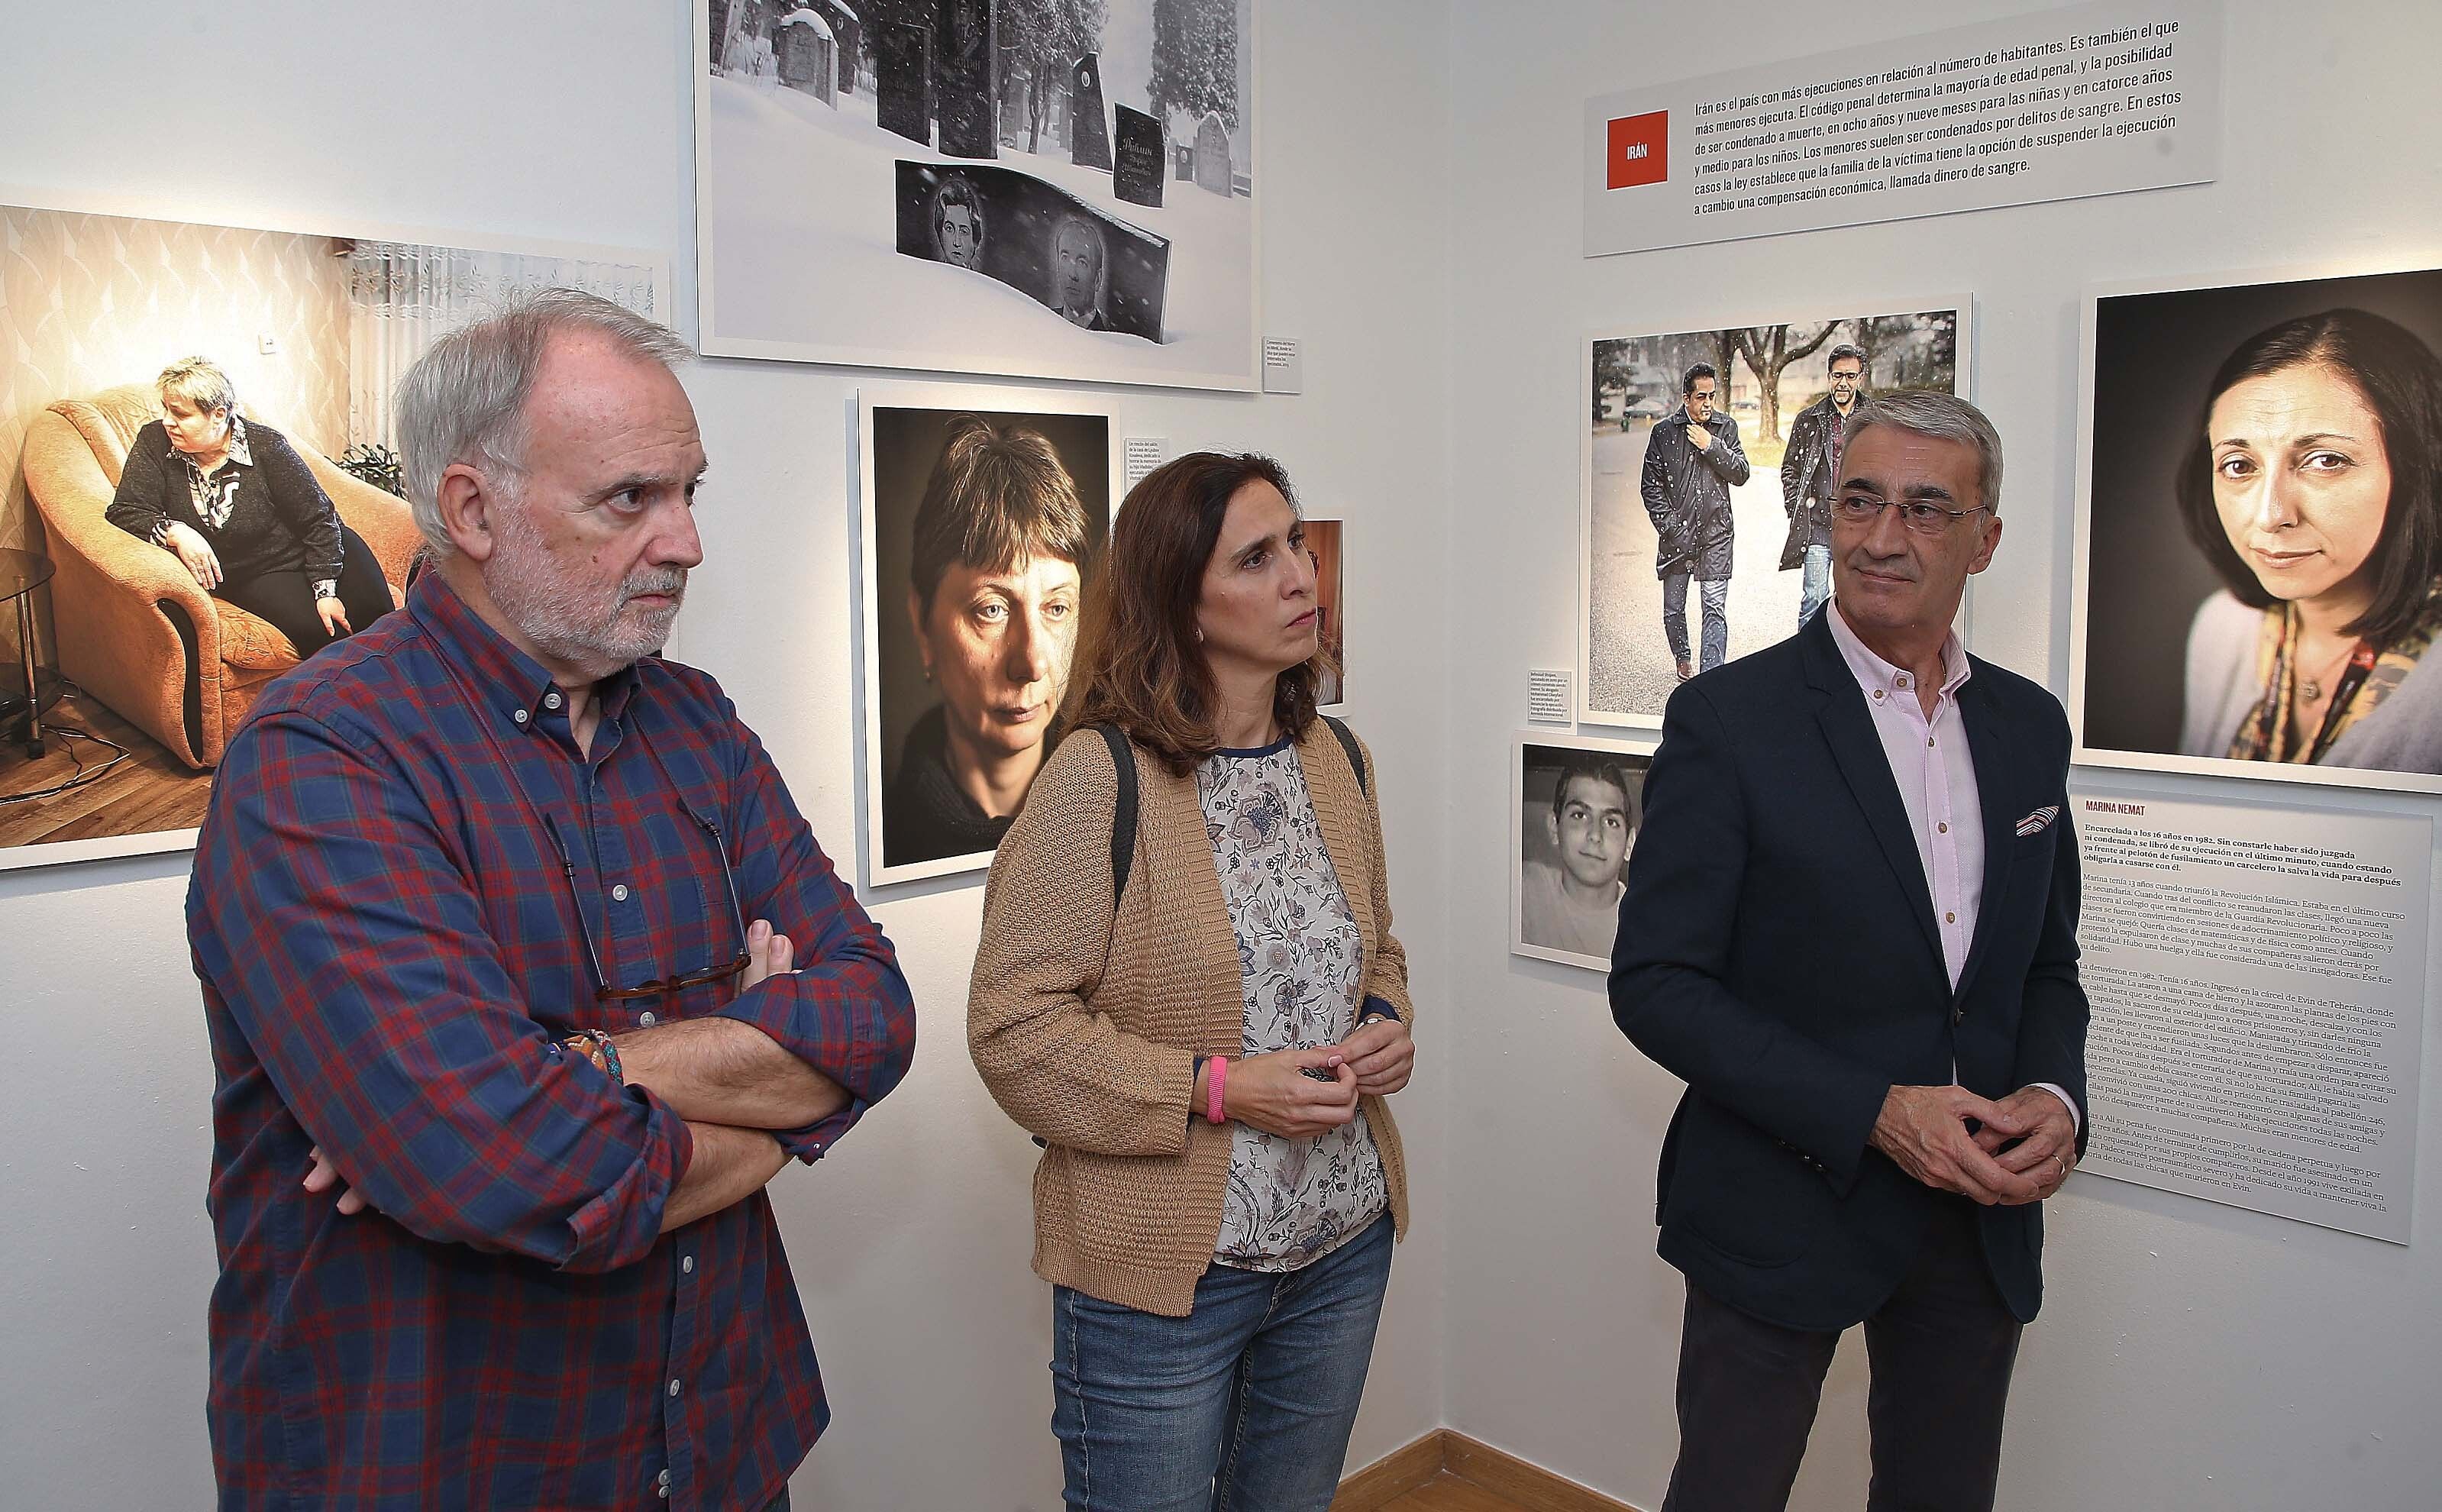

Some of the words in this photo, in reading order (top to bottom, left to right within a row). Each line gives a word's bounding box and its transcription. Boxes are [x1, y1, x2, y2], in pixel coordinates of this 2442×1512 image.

[1695, 102, 1713, 115] Irán
[1716, 102, 1726, 111] es
[1729, 96, 1736, 109] el
[1739, 93, 1759, 111] país
[1762, 92, 1778, 104] con
[1781, 86, 1801, 100] más
[1804, 77, 1862, 99] ejecuciones
[1865, 75, 1878, 86] en
[1882, 64, 1923, 83] relación
[1927, 60, 1936, 75] al
[1940, 57, 1980, 73] número
[1984, 51, 1997, 65] de
[2001, 42, 2066, 62] habitantes.
[2070, 35, 2084, 50] Es
[2088, 26, 2137, 47] también
[2141, 22, 2151, 37] el
[2155, 21, 2178, 37] que
[1695, 121, 1714, 135] más
[1716, 117, 1756, 132] menores
[1759, 109, 1796, 127] ejecuta.
[1799, 105, 1810, 118] El
[1811, 101, 1845, 116] código
[1846, 92, 1874, 113] penal
[1877, 86, 1930, 105] determina
[1933, 82, 1943, 95] la
[1946, 74, 1989, 94] mayoría
[1993, 71, 2006, 86] de
[2010, 65, 2037, 82] edad
[2041, 59, 2076, 81] penal,
[2080, 60, 2087, 74] y
[2091, 55, 2101, 69] la
[2104, 42, 2172, 70] posibilidad
[1694, 142, 1705, 155] de
[1708, 142, 1723, 153] ser
[1725, 131, 1776, 150] condenado
[1778, 132, 1785, 141] a
[1788, 125, 1824, 141] muerte,
[1827, 124, 1839, 134] en
[1843, 117, 1866, 131] ocho
[1869, 113, 1894, 128] años
[1898, 113, 1904, 126] y
[1907, 108, 1938, 121] nueve
[1941, 102, 1976, 116] meses
[1979, 97, 2004, 113] para
[2008, 92, 2024, 105] las
[2028, 86, 2059, 102] niñas
[2063, 86, 2070, 100] y
[2073, 83, 2087, 95] en
[2092, 76, 2138, 92] catorce
[2142, 68, 2172, 84] años
[1694, 166, 1699, 177] y
[1702, 159, 1729, 174] medio
[1732, 157, 1752, 172] para
[1756, 153, 1769, 166] los
[1772, 149, 1800, 163] niños.
[1804, 146, 1820, 158] Los
[1823, 140, 1866, 156] menores
[1869, 133, 1903, 148] suelen
[1907, 131, 1924, 143] ser
[1927, 119, 1992, 140] condenados
[1996, 117, 2014, 133] por
[2016, 111, 2056, 126] delitos
[2060, 105, 2074, 120] de
[2078, 102, 2122, 117] sangre.
[2127, 95, 2142, 110] En
[2146, 92, 2181, 107] estos
[1626, 141, 1648, 160] IRÁN
[1694, 183, 1720, 195] casos
[1723, 178, 1731, 190] la
[1734, 176, 1747, 190] ley
[1749, 170, 1797, 186] establece
[1798, 169, 1816, 182] que
[1819, 164, 1827, 177] la
[1830, 159, 1864, 175] familia
[1867, 157, 1881, 170] de
[1882, 155, 1891, 168] la
[1894, 150, 1932, 166] víctima
[1936, 147, 1962, 160] tiene
[1966, 143, 1975, 156] la
[1978, 137, 2015, 157] opción
[2019, 134, 2033, 148] de
[2037, 125, 2098, 147] suspender
[2101, 123, 2112, 137] la
[2116, 114, 2175, 137] ejecución
[1694, 205, 1699, 215] a
[1702, 198, 1734, 213] cambio
[1737, 198, 1755, 208] una
[1757, 185, 1826, 206] compensación
[1827, 179, 1886, 196] económica,
[1890, 171, 1930, 188] llamada
[1933, 169, 1968, 182] dinero
[1971, 163, 1984, 177] de
[1988, 160, 2030, 175] sangre.
[2085, 800, 2117, 813] MARINA
[2118, 803, 2146, 816] NEMAT
[2083, 853, 2117, 864] obligarla
[2083, 843, 2092, 851] ya
[2094, 844, 2117, 853] frente
[2127, 849, 2157, 858] pelotón
[2170, 852, 2222, 865] fusilamiento
[2236, 862, 2276, 871] carcelero
[2277, 864, 2285, 873] la
[2287, 867, 2310, 875] salva
[2321, 870, 2340, 879] vida
[2363, 874, 2401, 886] después
[2085, 824, 2131, 835] Encarcelada
[2139, 829, 2151, 837] los
[2232, 838, 2272, 850] constarle
[2273, 843, 2298, 852] haber
[2299, 846, 2318, 855] sido
[2321, 848, 2355, 859] juzgada
[2093, 835, 2137, 847] condenada,
[2149, 840, 2168, 849] libró
[2192, 845, 2231, 856] ejecución
[2254, 851, 2282, 861] último
[2285, 856, 2319, 867] minuto,
[2321, 861, 2353, 869] cuando
[2354, 864, 2392, 874] estando
[2083, 873, 2108, 882] Marina
[2135, 880, 2153, 888] años
[2184, 886, 2210, 895] triunfó
[2220, 890, 2263, 902] Revolución
[2263, 895, 2300, 906] Islámica.
[2301, 900, 2328, 910] Estaba
[2351, 906, 2379, 916] último
[2381, 911, 2405, 919] curso
